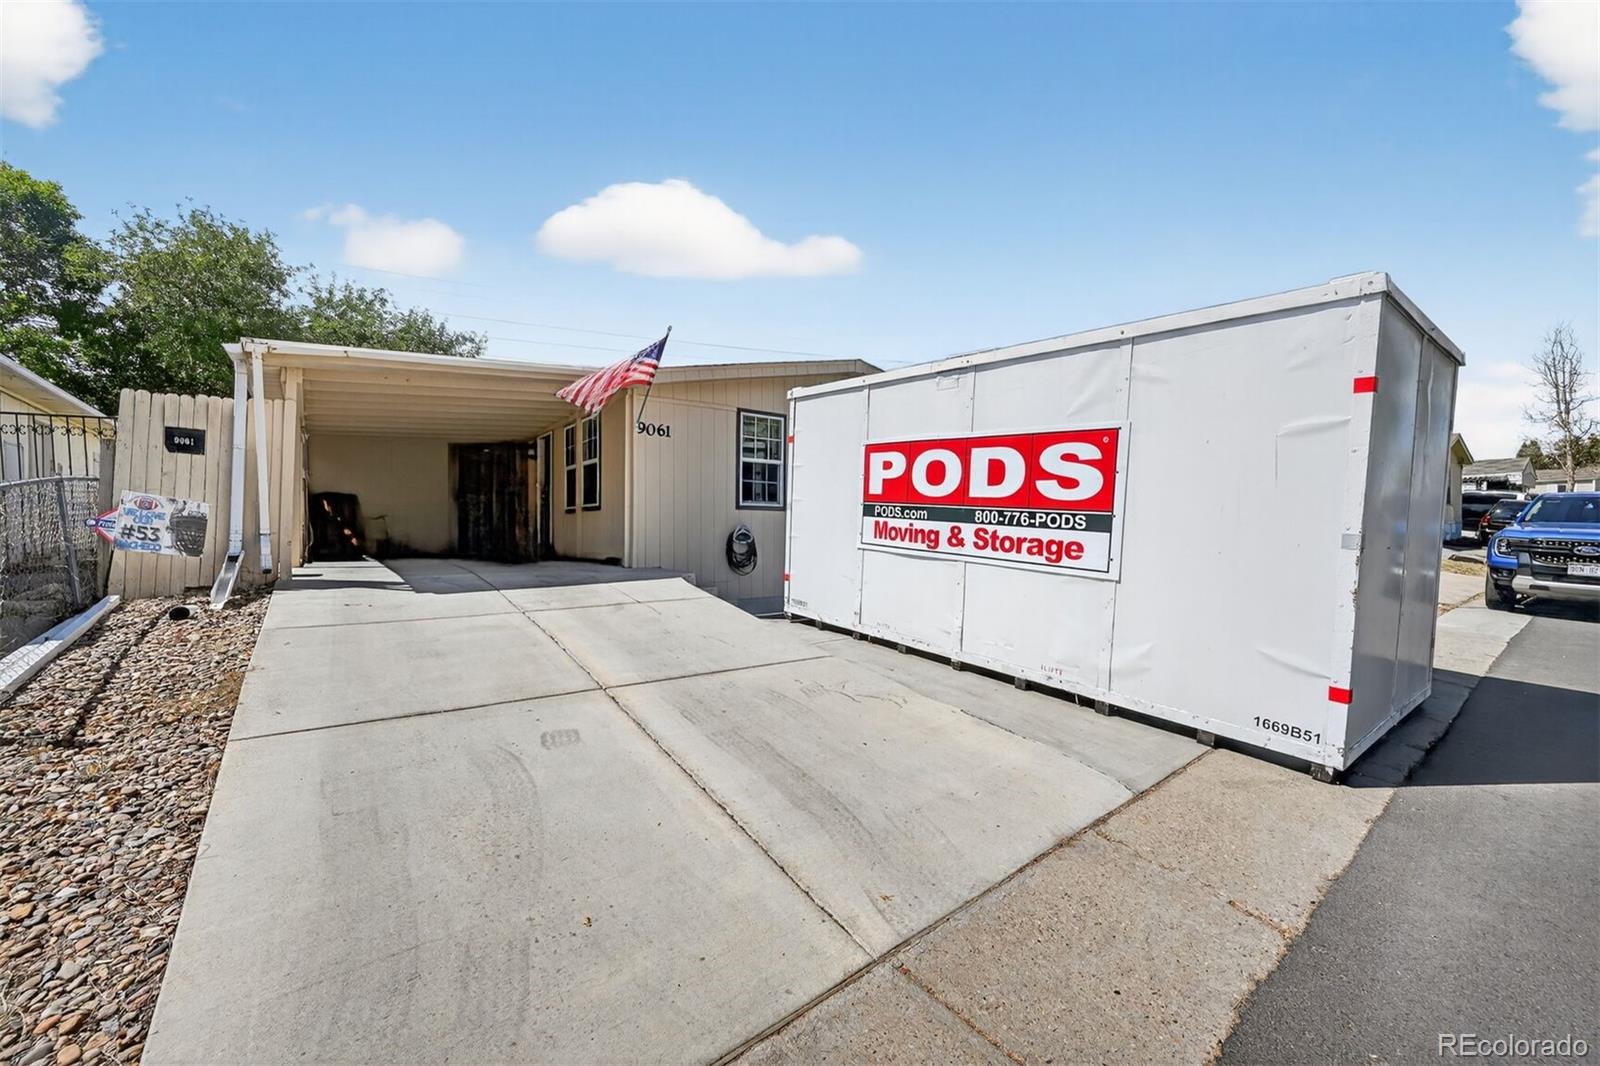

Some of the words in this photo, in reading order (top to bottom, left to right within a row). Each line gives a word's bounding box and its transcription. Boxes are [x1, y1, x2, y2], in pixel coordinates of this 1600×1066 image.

[637, 421, 671, 437] 9061
[174, 436, 194, 446] 9061
[868, 441, 1104, 501] PODS
[874, 505, 928, 520] PODS.com
[974, 510, 1087, 529] 800-776-PODS
[119, 523, 160, 542] #53
[873, 520, 940, 549] Moving
[947, 525, 965, 548] &
[973, 527, 1084, 563] Storage
[1253, 715, 1321, 744] 1669B51
